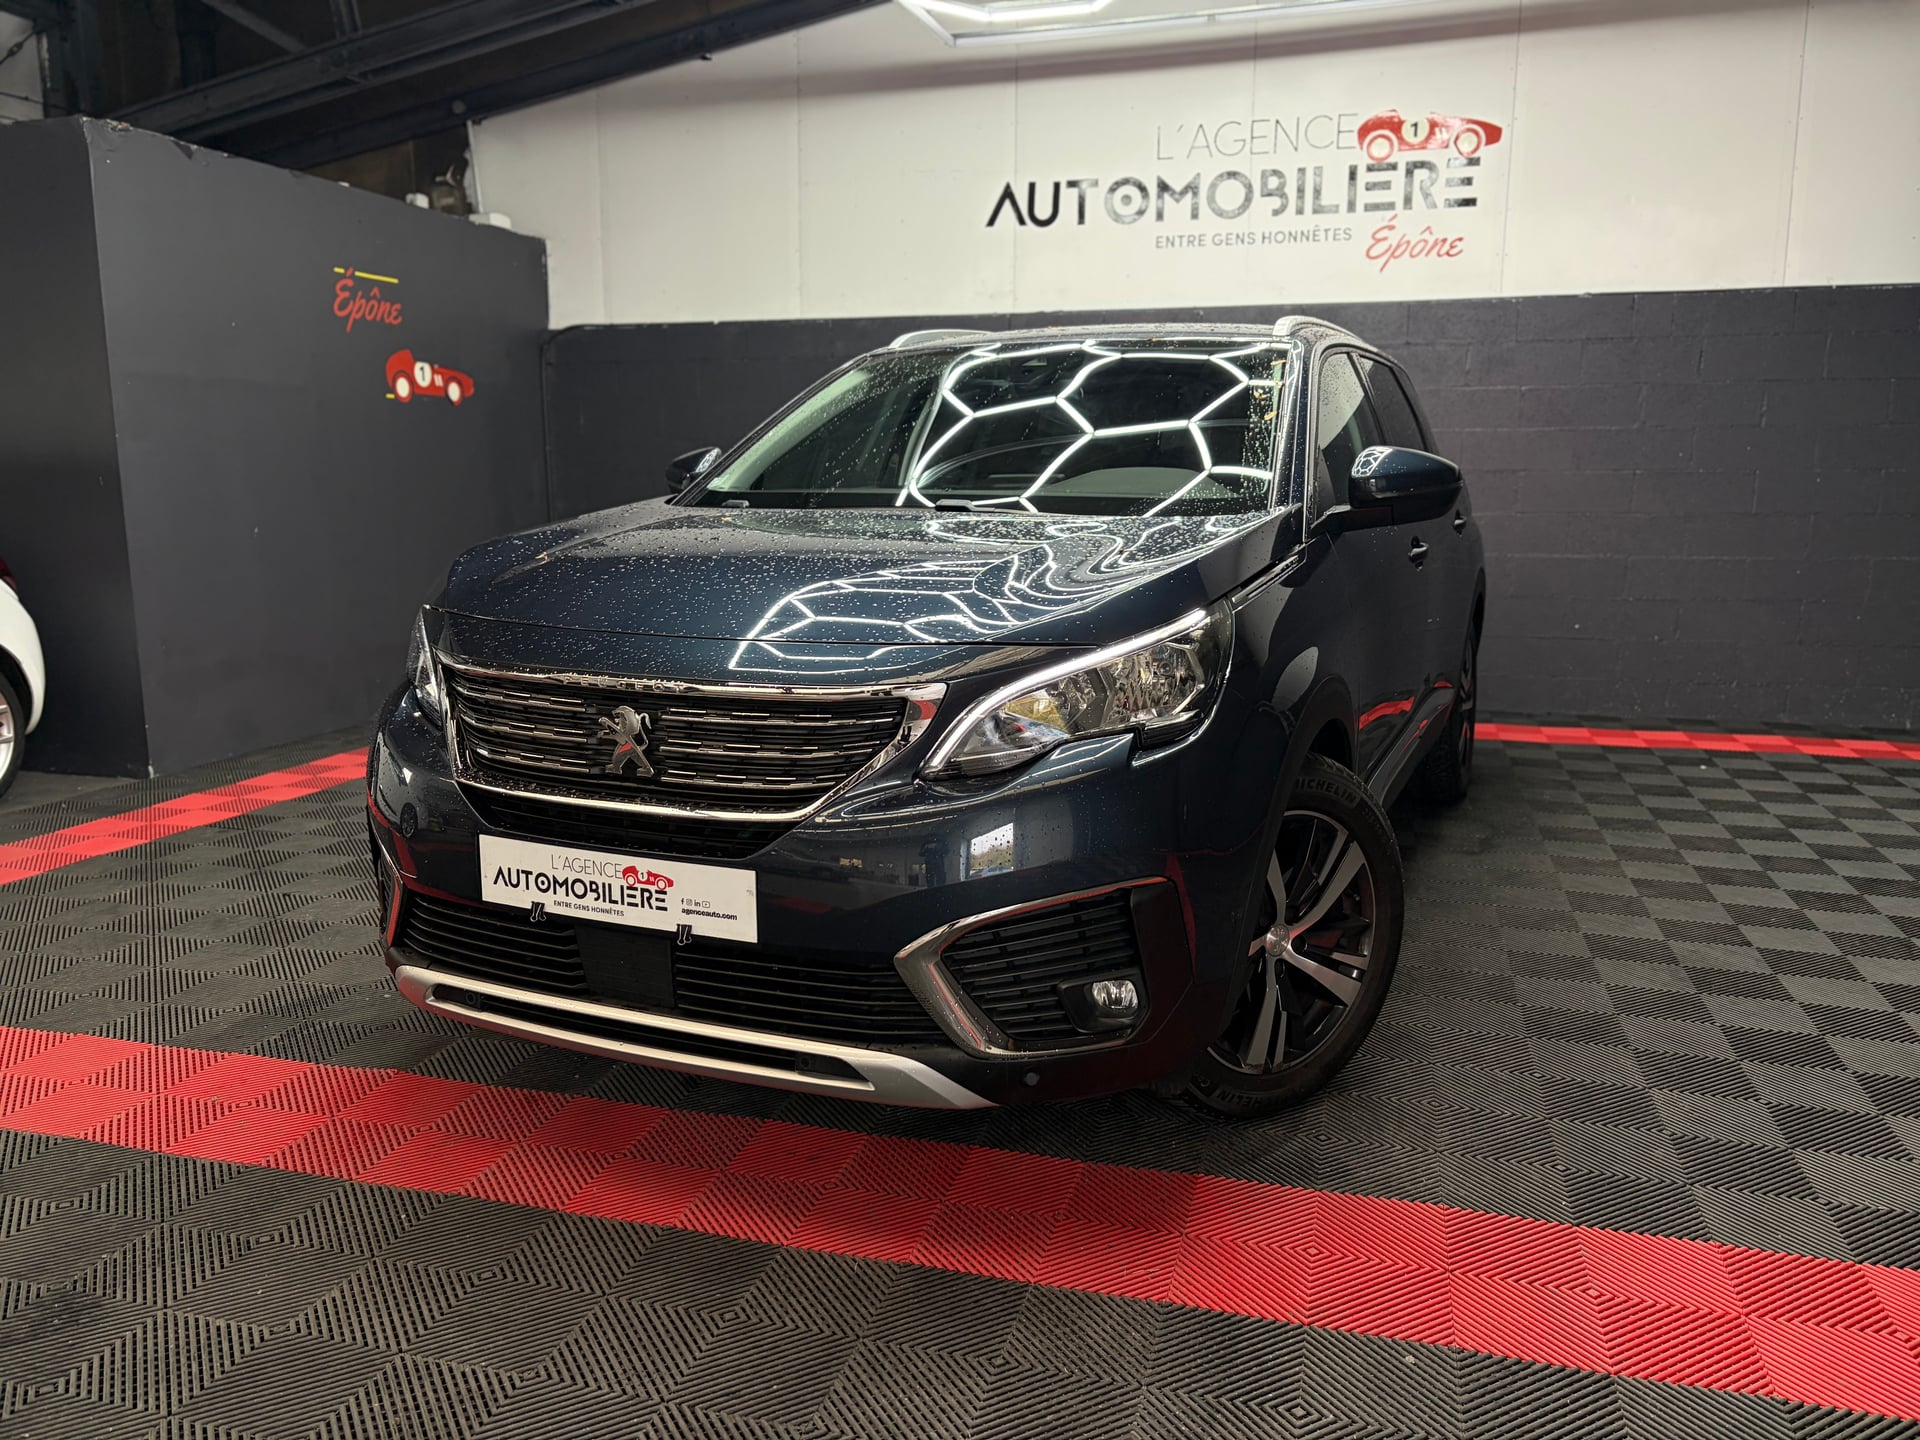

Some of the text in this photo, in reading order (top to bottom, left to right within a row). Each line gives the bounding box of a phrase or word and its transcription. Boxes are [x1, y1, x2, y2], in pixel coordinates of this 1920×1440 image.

[1410, 121, 1419, 137] 1
[1155, 225, 1353, 249] ENTRE GENS HONNÊTES
[1365, 213, 1465, 273] Épône
[333, 267, 403, 333] Épône
[419, 365, 426, 382] 1
[551, 853, 623, 880] L'AGENCE
[553, 899, 573, 909] ENTRE
[573, 903, 590, 912] GENS
[681, 907, 738, 921] agenceauto.com
